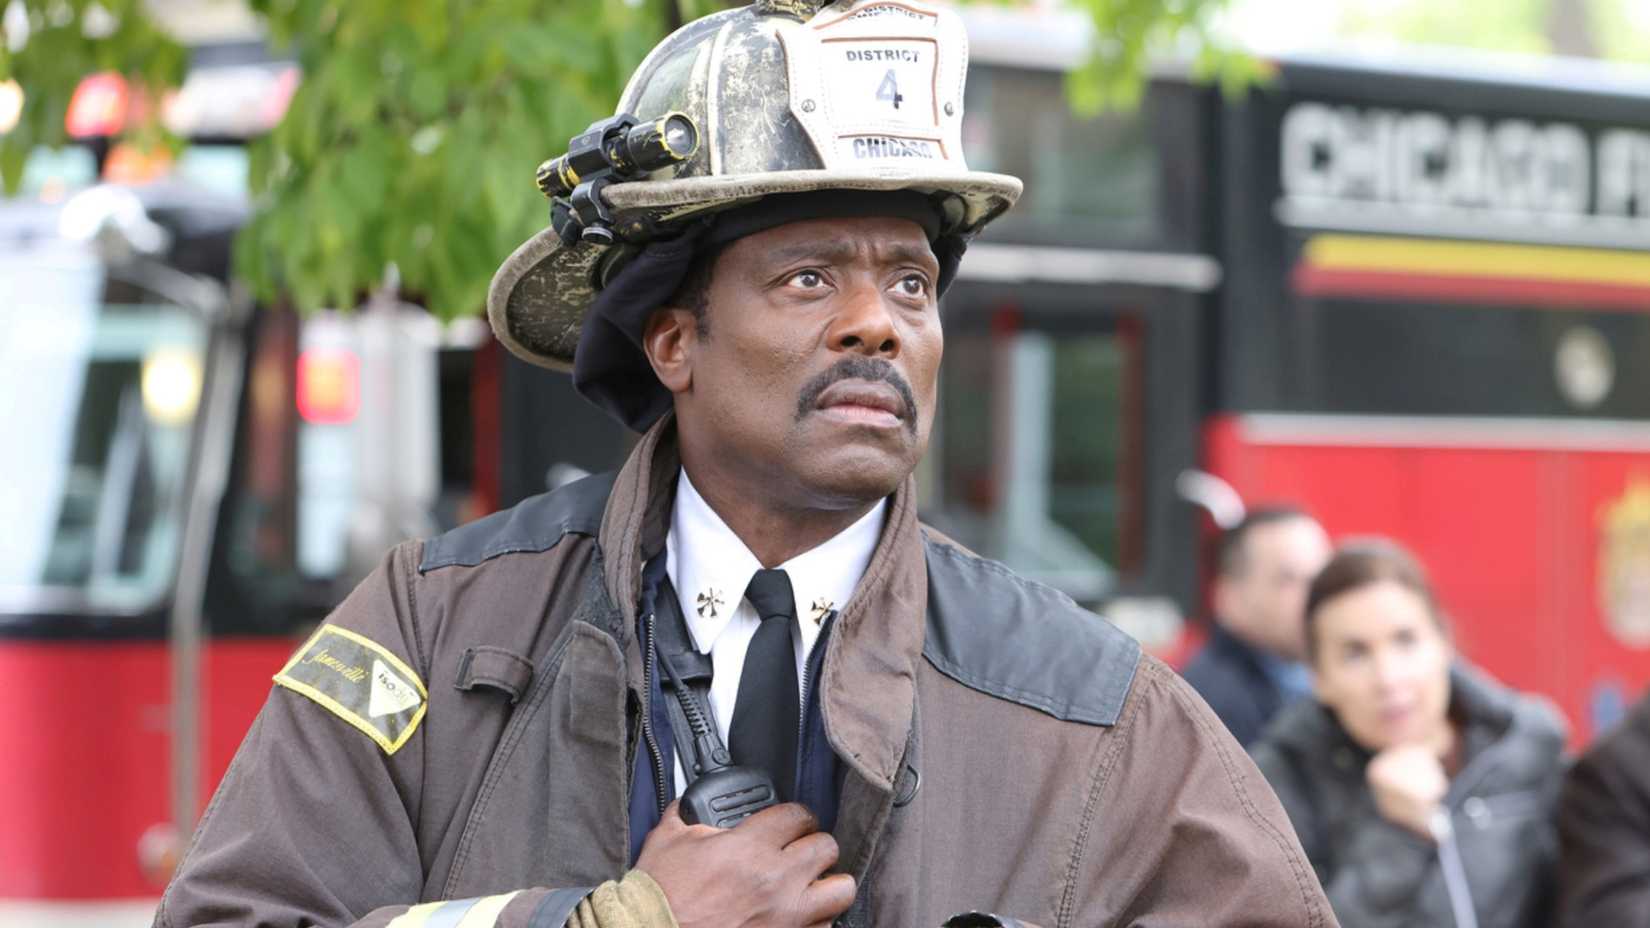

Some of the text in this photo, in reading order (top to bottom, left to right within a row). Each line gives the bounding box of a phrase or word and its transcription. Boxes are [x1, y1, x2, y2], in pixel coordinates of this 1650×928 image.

[846, 49, 920, 63] DISTRICT
[875, 68, 903, 110] 4
[1280, 102, 1591, 215] CHICAGO
